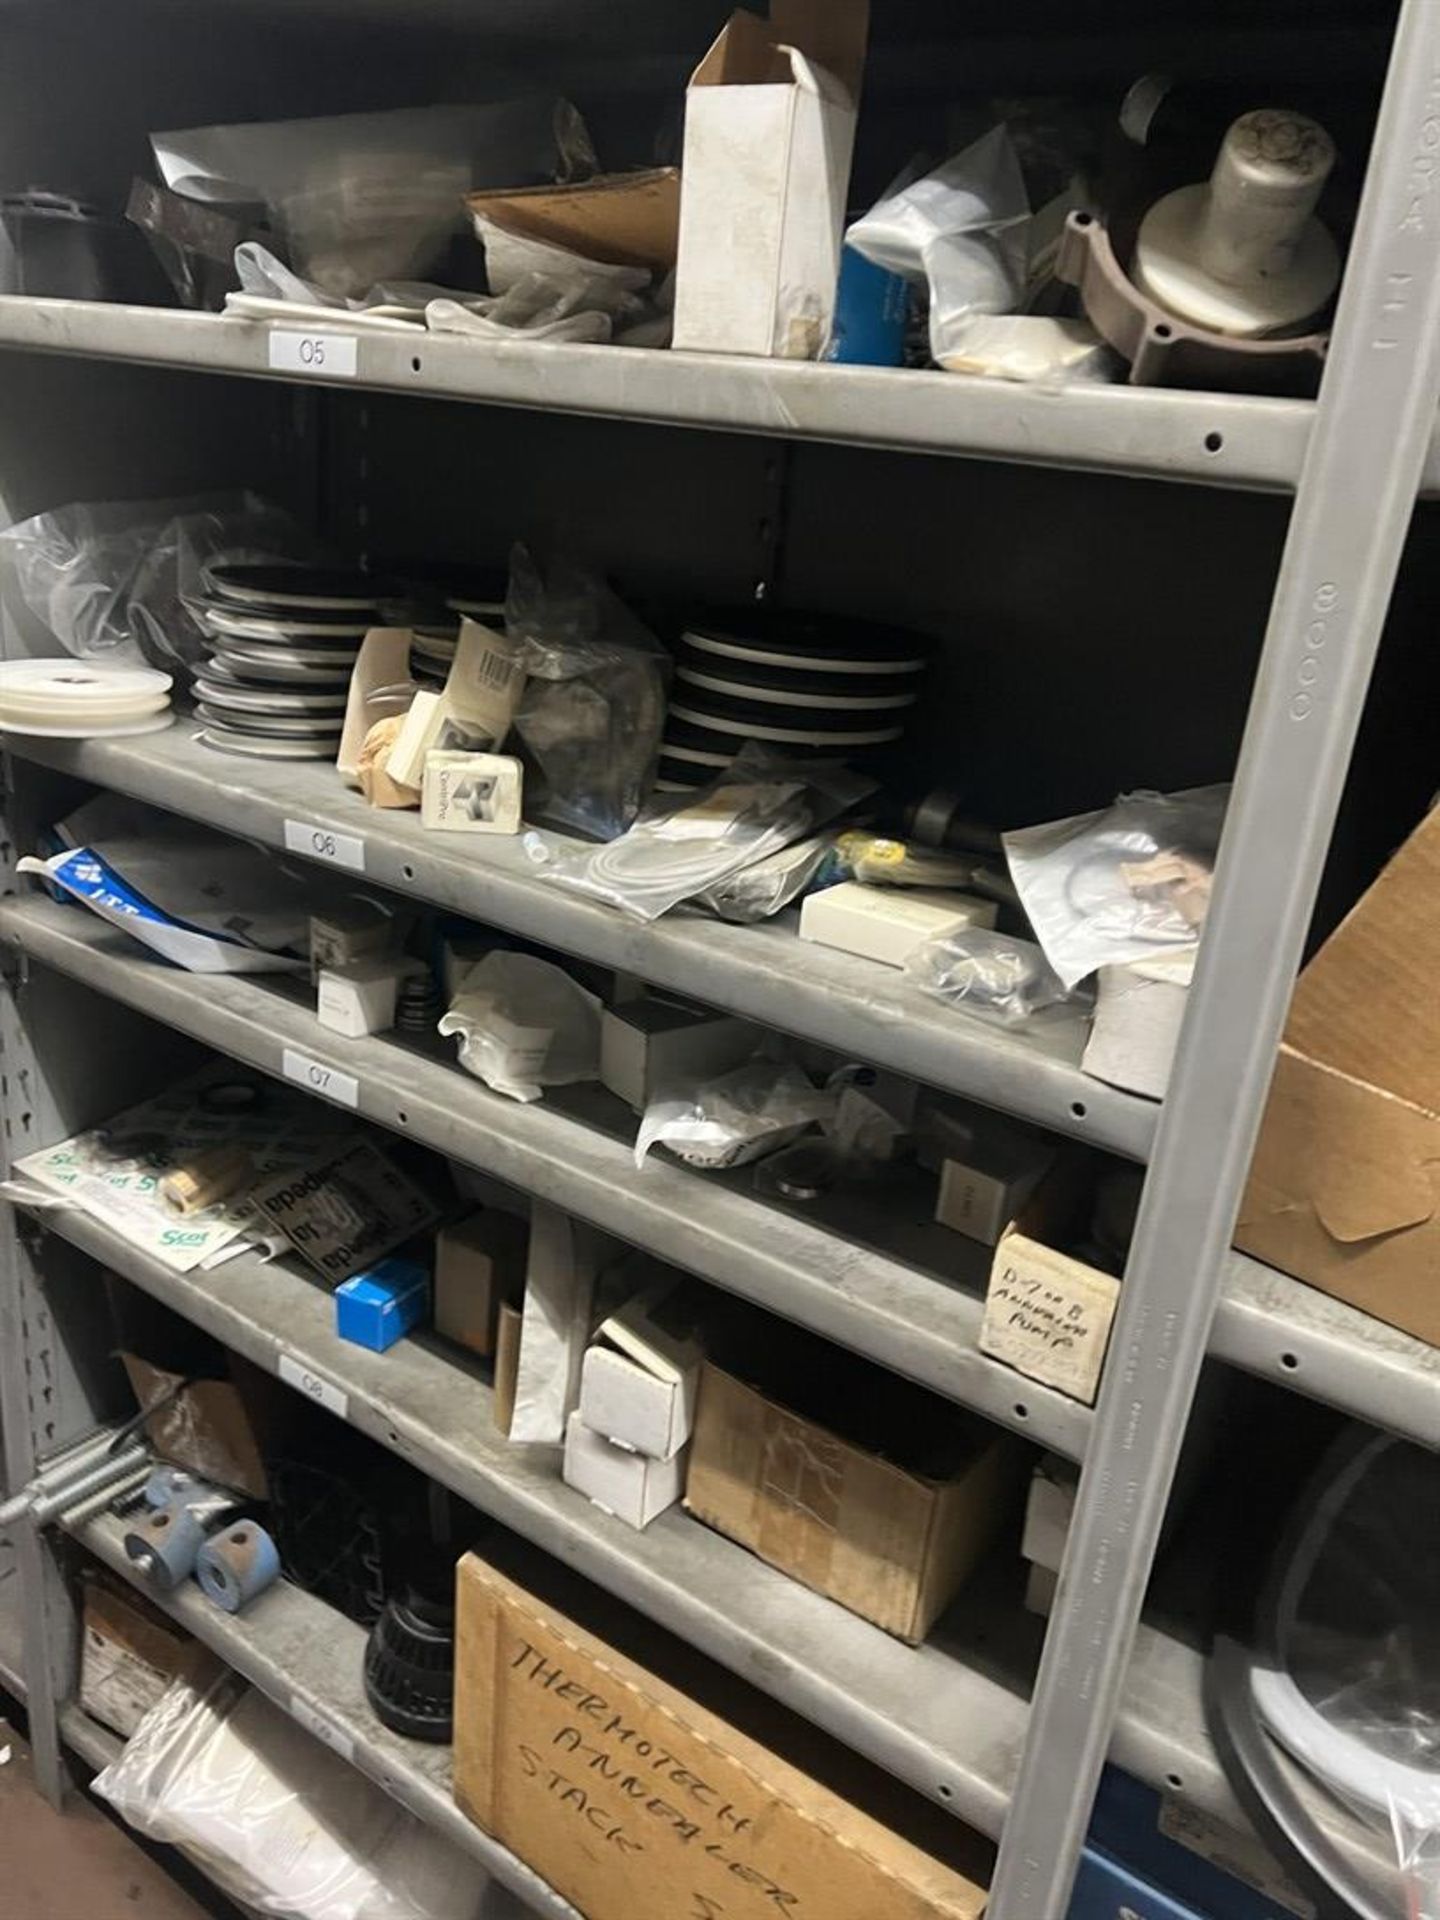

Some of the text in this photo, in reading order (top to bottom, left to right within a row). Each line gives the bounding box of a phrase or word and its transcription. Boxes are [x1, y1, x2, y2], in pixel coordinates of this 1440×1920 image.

[511, 1641, 751, 1834] THERMOTECH
[517, 1743, 644, 1854] STACK
[552, 1726, 800, 1919] ANNEALER
